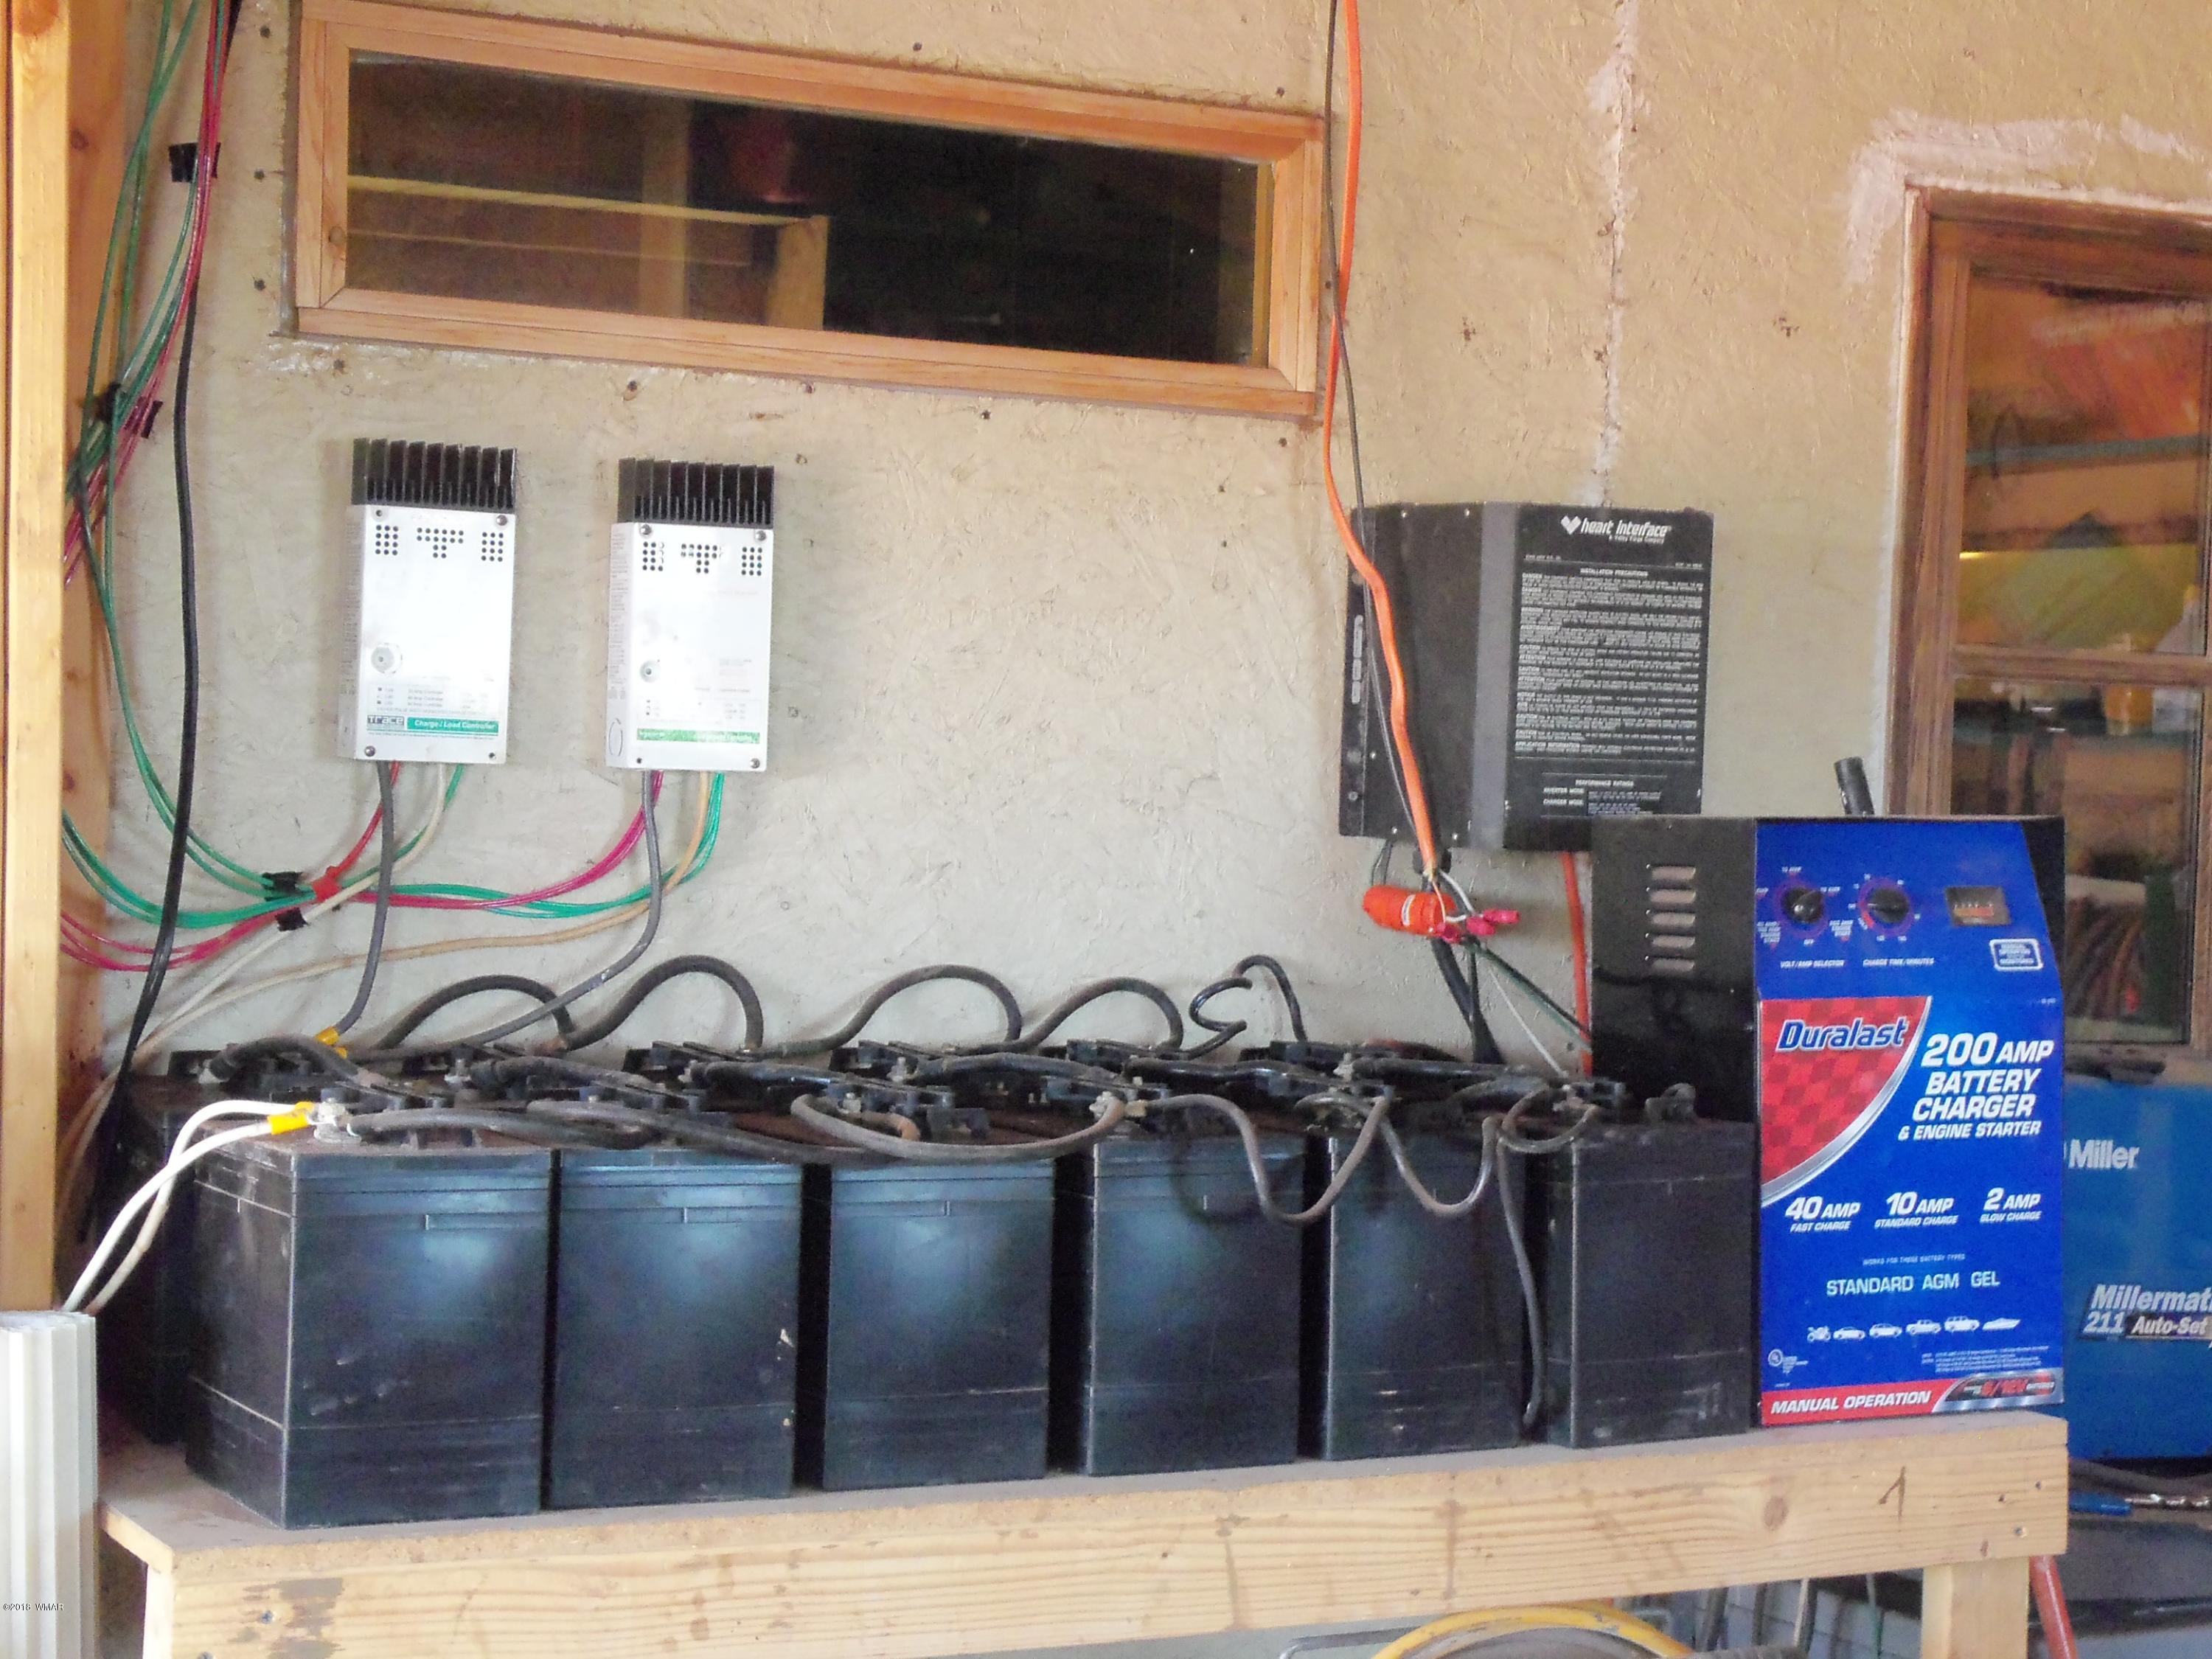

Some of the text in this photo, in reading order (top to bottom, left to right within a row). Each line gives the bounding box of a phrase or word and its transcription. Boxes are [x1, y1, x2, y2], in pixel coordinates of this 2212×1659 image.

[1580, 518, 1668, 538] heart interface
[414, 720, 439, 728] Charge
[443, 720, 461, 728] Load
[462, 722, 495, 730] Controller
[1813, 959, 1846, 968] SELECTOR
[1863, 959, 1888, 967] CHARGE
[1775, 1017, 1910, 1052] Duralast
[1921, 1032, 2055, 1068] 200 AMP
[1924, 1068, 2042, 1096] BATTERY
[1912, 1094, 2037, 1121] CHARGER
[1898, 1121, 2042, 1141] & ENGINE STARTER
[2068, 1138, 2140, 1169] Miller
[1784, 1196, 1862, 1222] 40 AMP
[1886, 1192, 1955, 1217] 10 AMP
[1983, 1187, 2042, 1211] 2 AMP
[1790, 1220, 1851, 1234] FAST CHARGE
[1874, 1215, 1958, 1229] STANDARD CHARGE
[1980, 1211, 2042, 1224] SLOW CHARGE
[1826, 1270, 2000, 1296] STANDARD AGM GEL
[2083, 1311, 2208, 1336] 211 Auto-Set
[1771, 1390, 1931, 1416] MANUAL OPERATION
